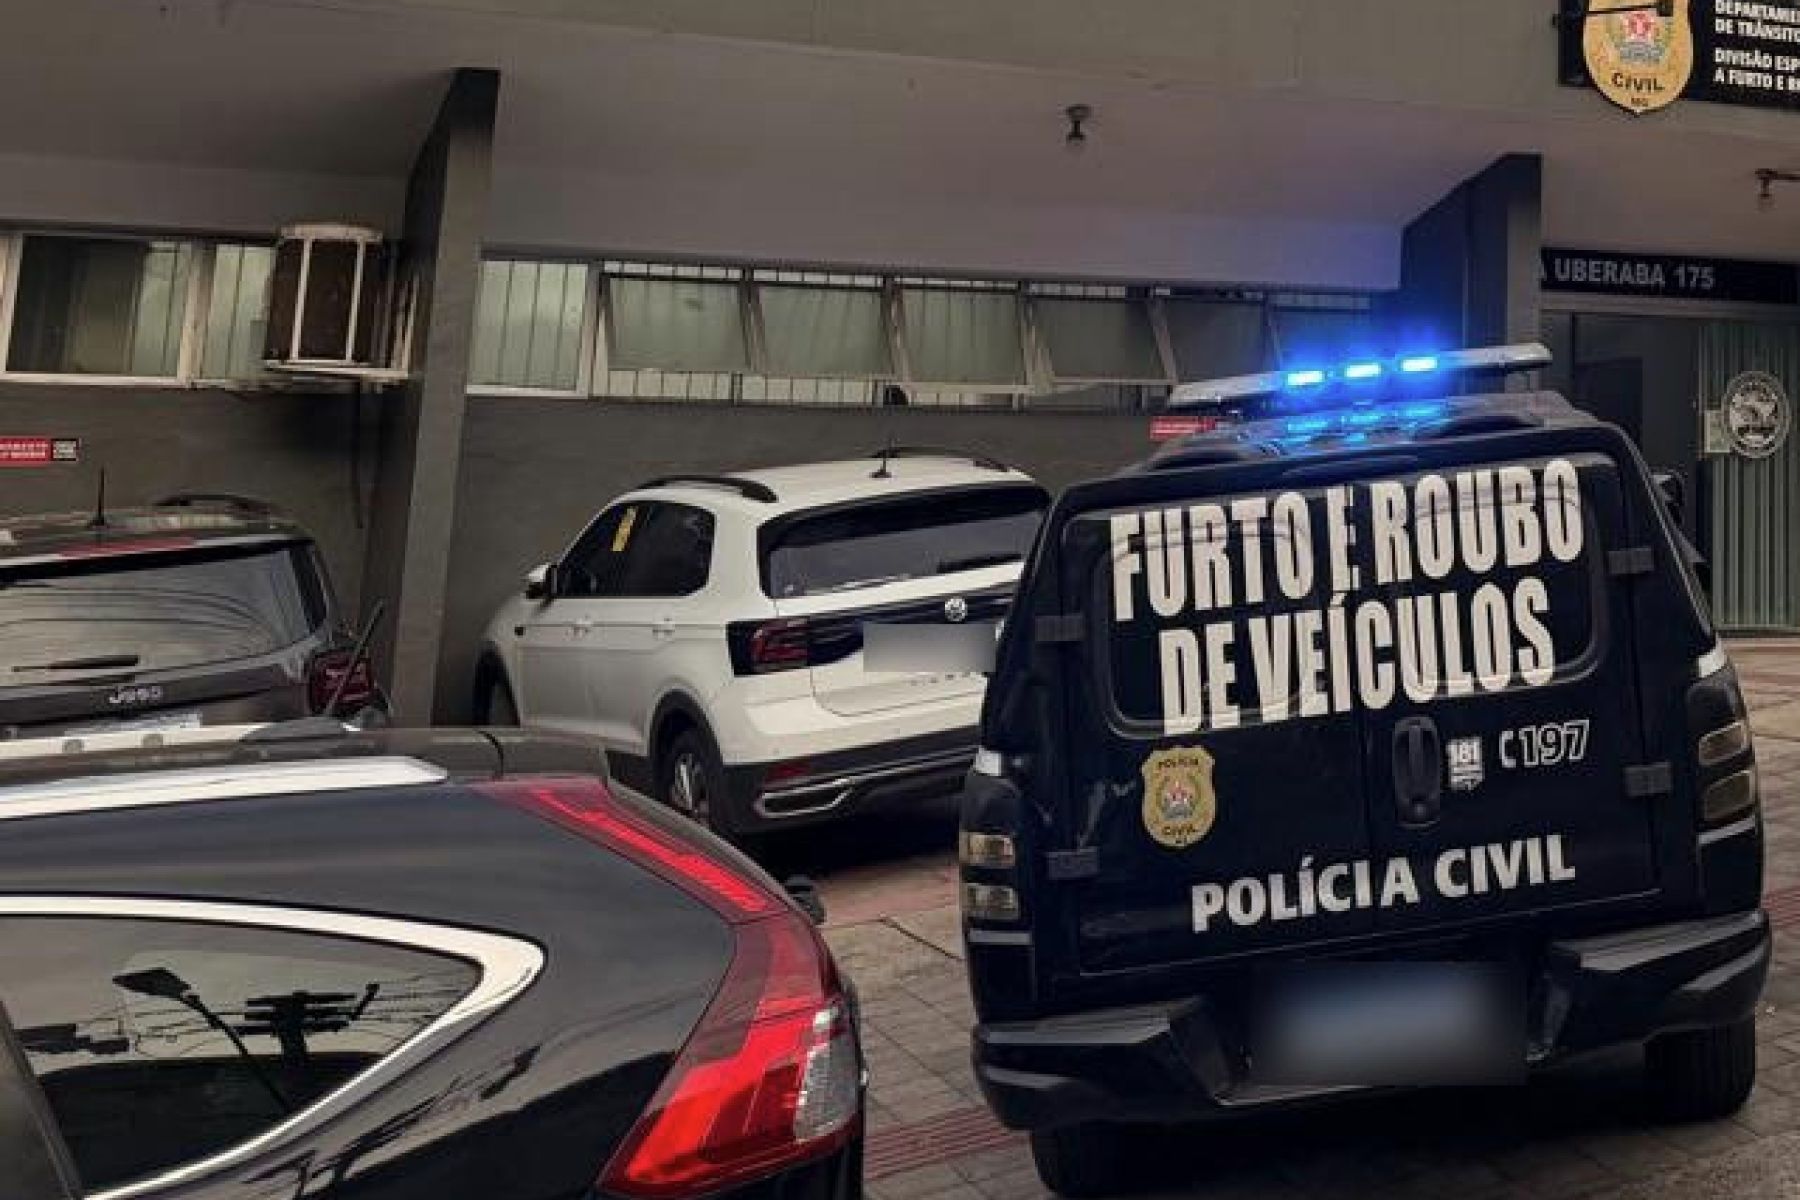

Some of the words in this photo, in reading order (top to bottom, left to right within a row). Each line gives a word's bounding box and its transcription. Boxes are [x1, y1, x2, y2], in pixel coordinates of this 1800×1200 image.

[1715, 18, 1734, 34] DE
[1715, 47, 1772, 68] DIVISÃO
[1611, 72, 1664, 93] CIVIL
[1729, 69, 1773, 88] FURTO
[1776, 74, 1785, 90] E
[1554, 257, 1665, 286] UBERABA
[1673, 263, 1714, 290] 175
[1109, 492, 1315, 623] FURTO
[1328, 484, 1360, 592] E
[1371, 457, 1584, 587] ROUBO
[1159, 624, 1241, 737] DE
[1248, 577, 1556, 725] VEÍCULOS
[1518, 718, 1590, 768] 197
[1191, 857, 1418, 933] POLÍCIA
[1434, 834, 1577, 900] CIVIL
